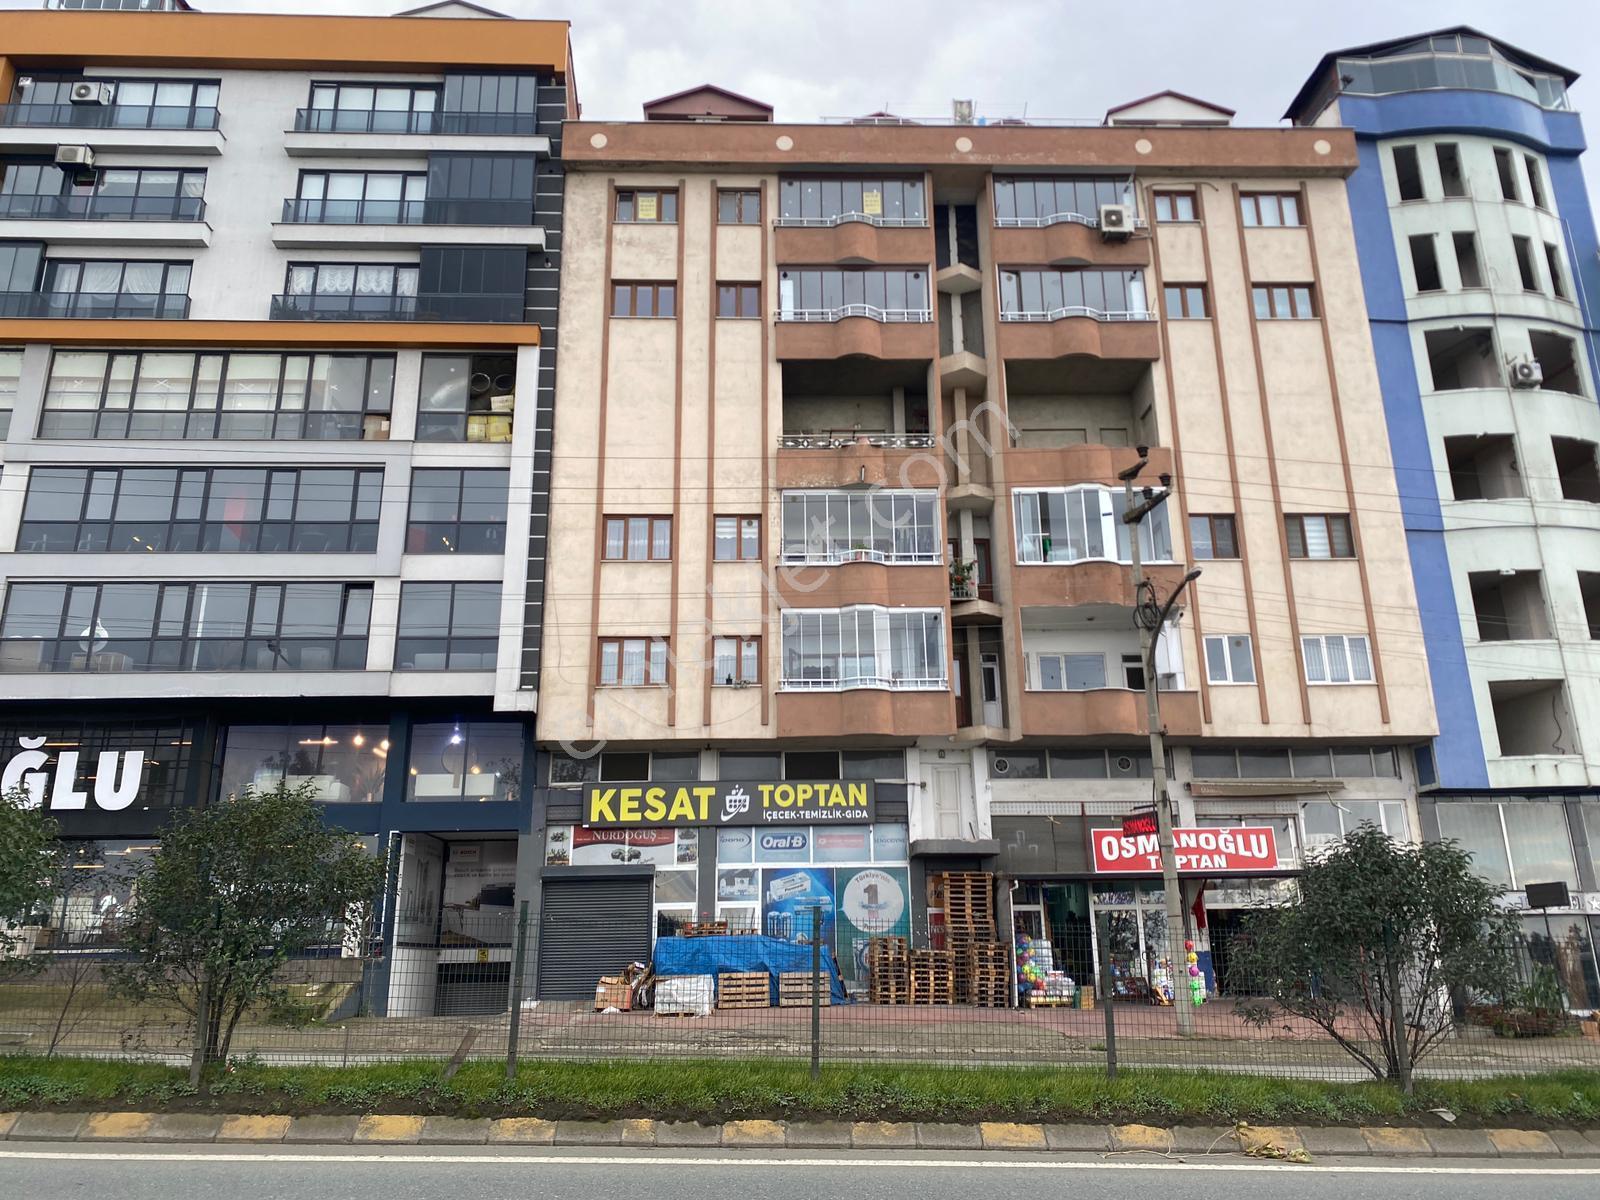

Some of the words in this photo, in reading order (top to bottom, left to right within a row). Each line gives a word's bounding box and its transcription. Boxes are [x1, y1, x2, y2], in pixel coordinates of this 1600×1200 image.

[0, 736, 145, 811] ĞLU
[590, 786, 716, 822] KESAT
[758, 783, 868, 808] TOPTAN
[763, 836, 804, 848] Oral-B
[1101, 828, 1269, 861] OSMNOĞLU
